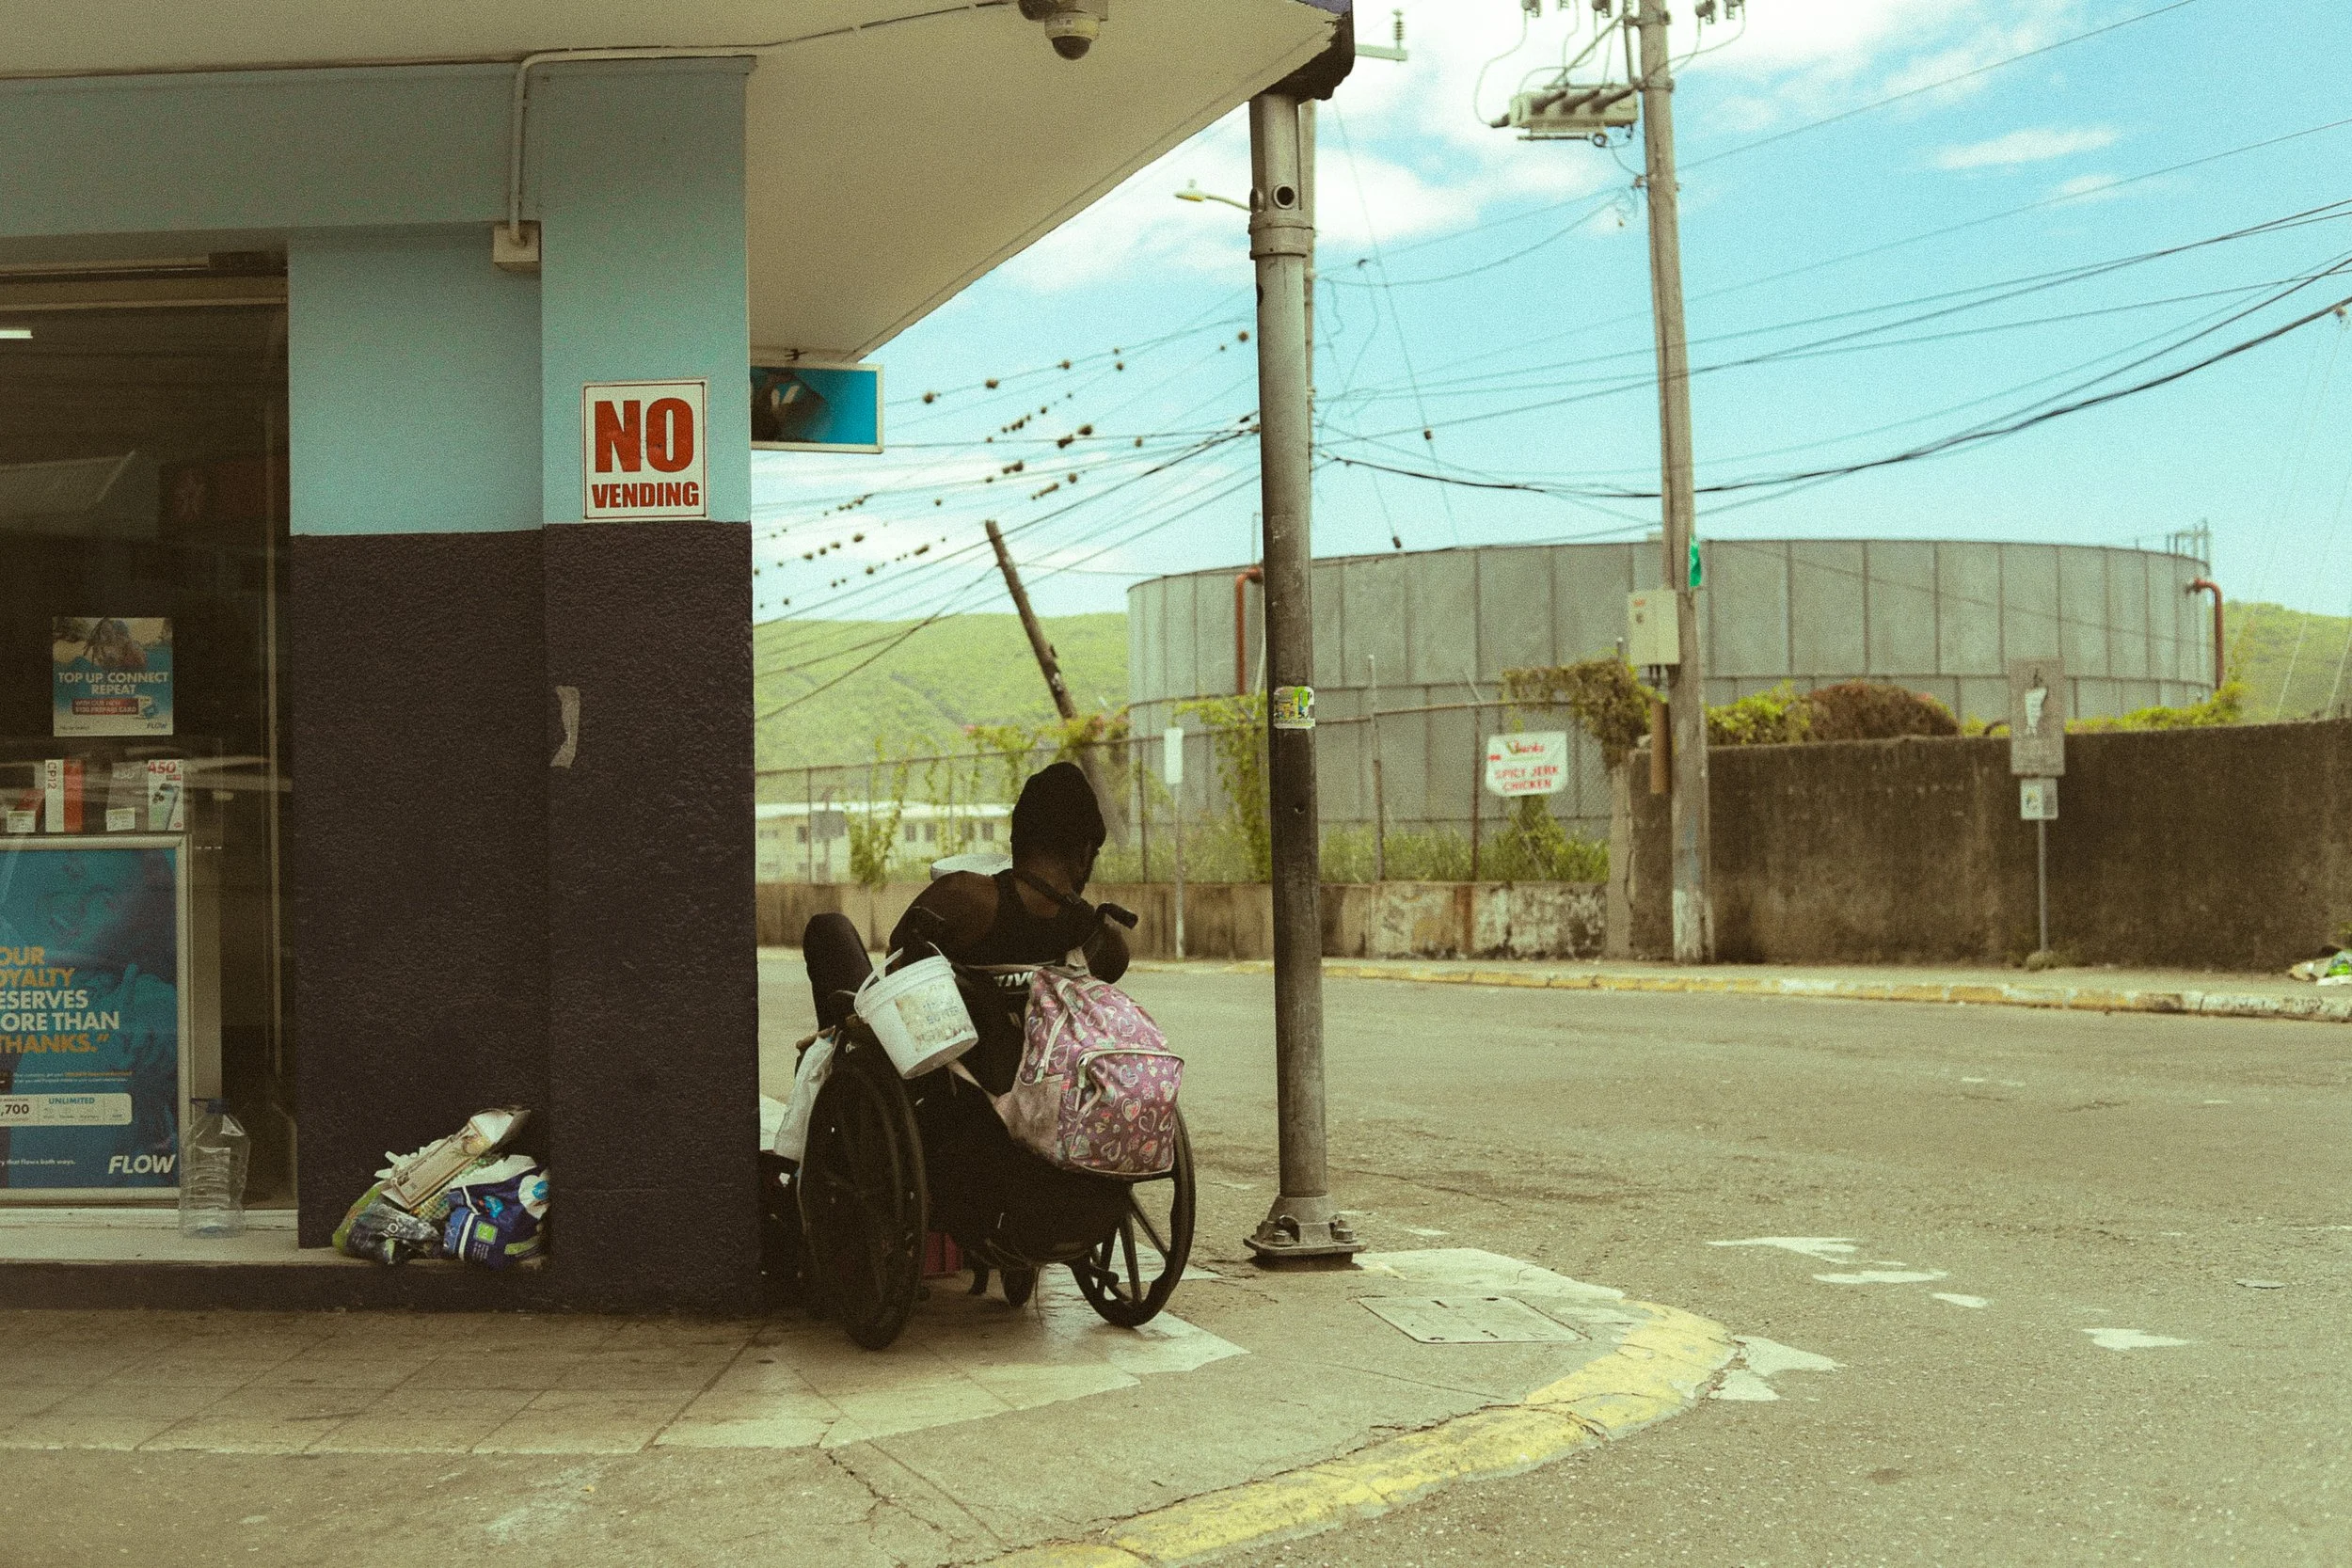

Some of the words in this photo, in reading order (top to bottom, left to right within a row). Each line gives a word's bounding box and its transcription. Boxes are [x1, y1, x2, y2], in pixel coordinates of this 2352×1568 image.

[594, 397, 694, 473] NO
[592, 481, 699, 509] VENDING
[58, 672, 83, 683] TOP
[90, 684, 136, 695] REPEAT
[52, 1011, 119, 1030] THAN
[48, 1097, 95, 1105] UNLIMITED
[108, 1153, 177, 1175] FLOW
